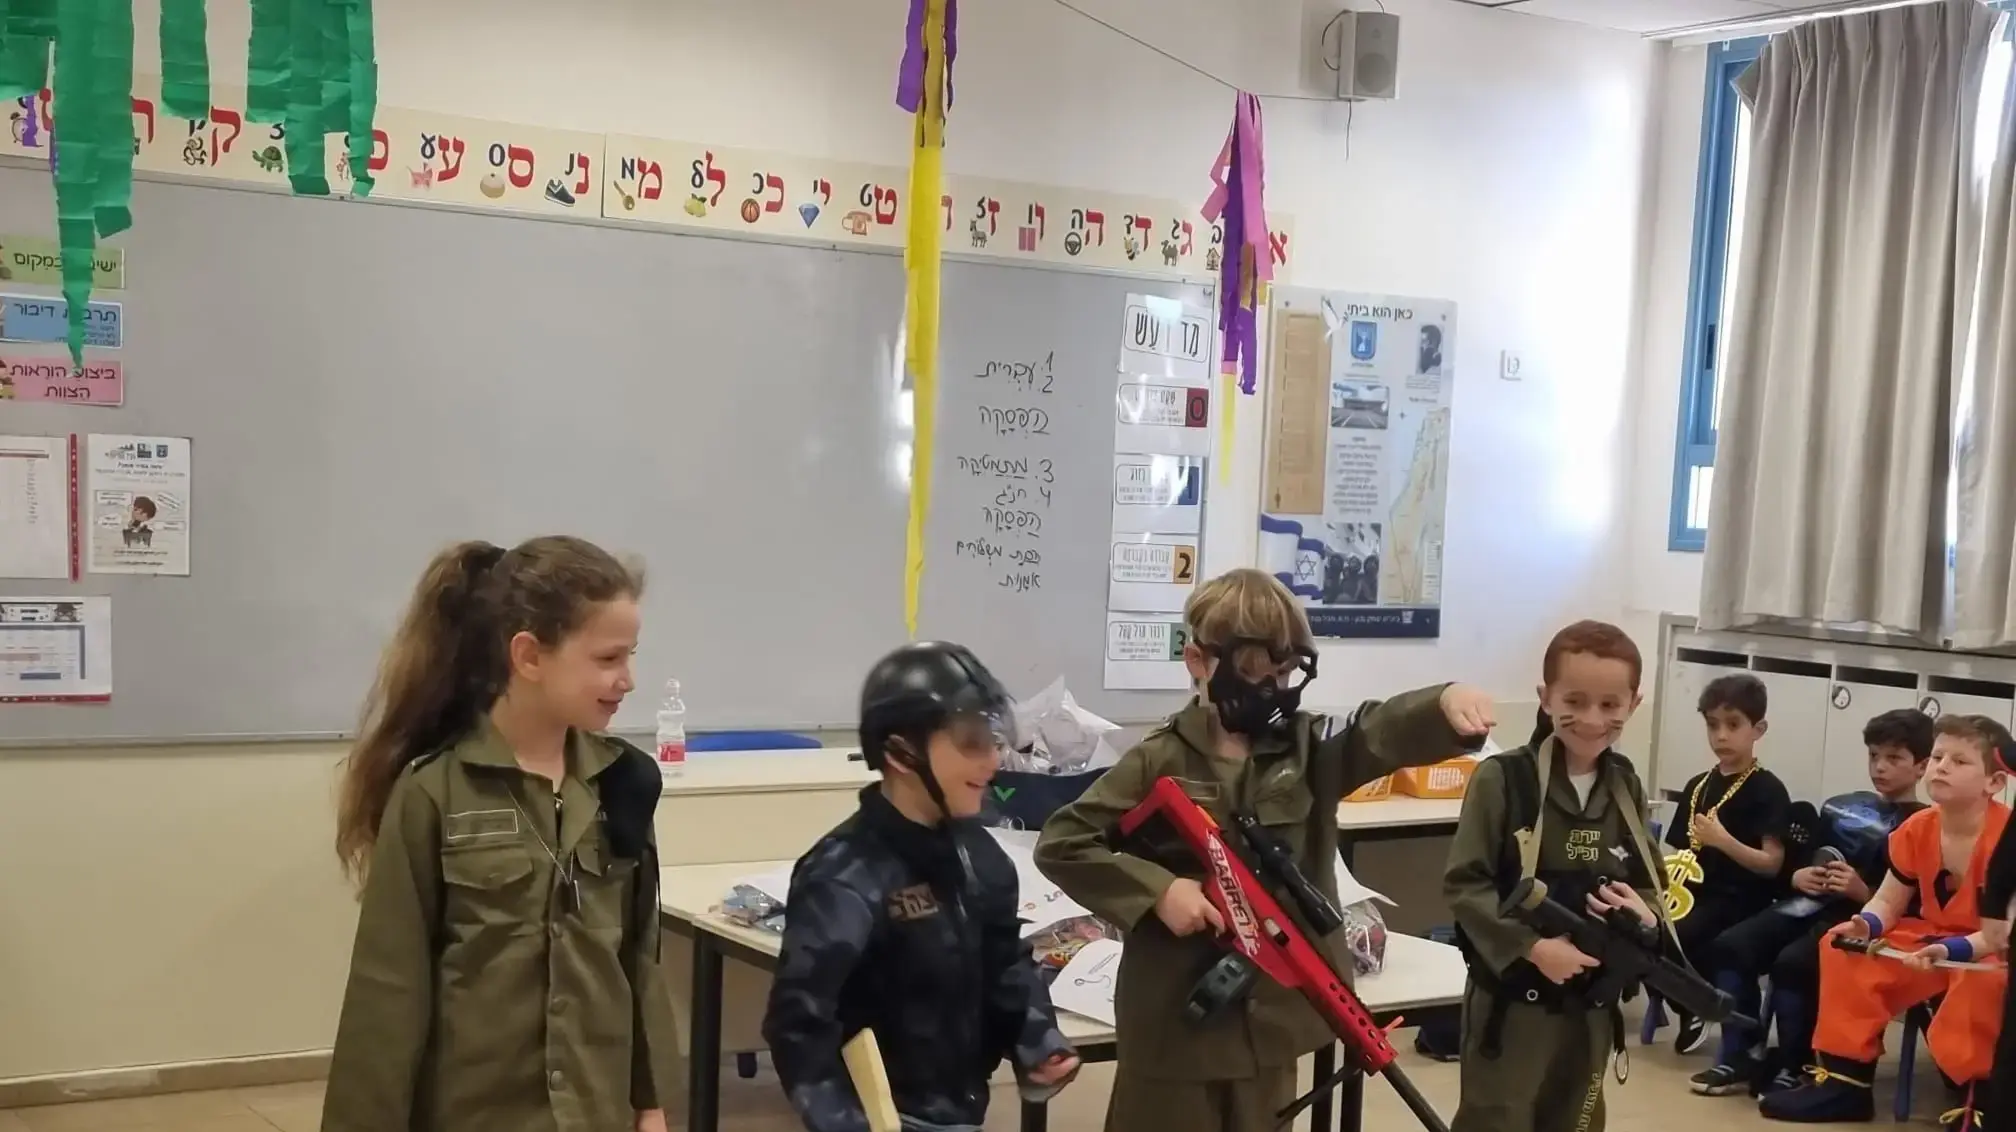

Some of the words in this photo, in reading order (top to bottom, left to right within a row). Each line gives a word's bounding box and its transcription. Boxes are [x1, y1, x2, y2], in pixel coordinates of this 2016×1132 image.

[14, 302, 55, 318] דיבור
[1347, 303, 1369, 317] ביתי
[1372, 305, 1392, 319] הוא
[1394, 307, 1414, 322] כאן
[10, 363, 67, 379] הוראות
[45, 385, 91, 400] הצוות
[1189, 396, 1205, 422] 0
[1178, 552, 1192, 579] 2
